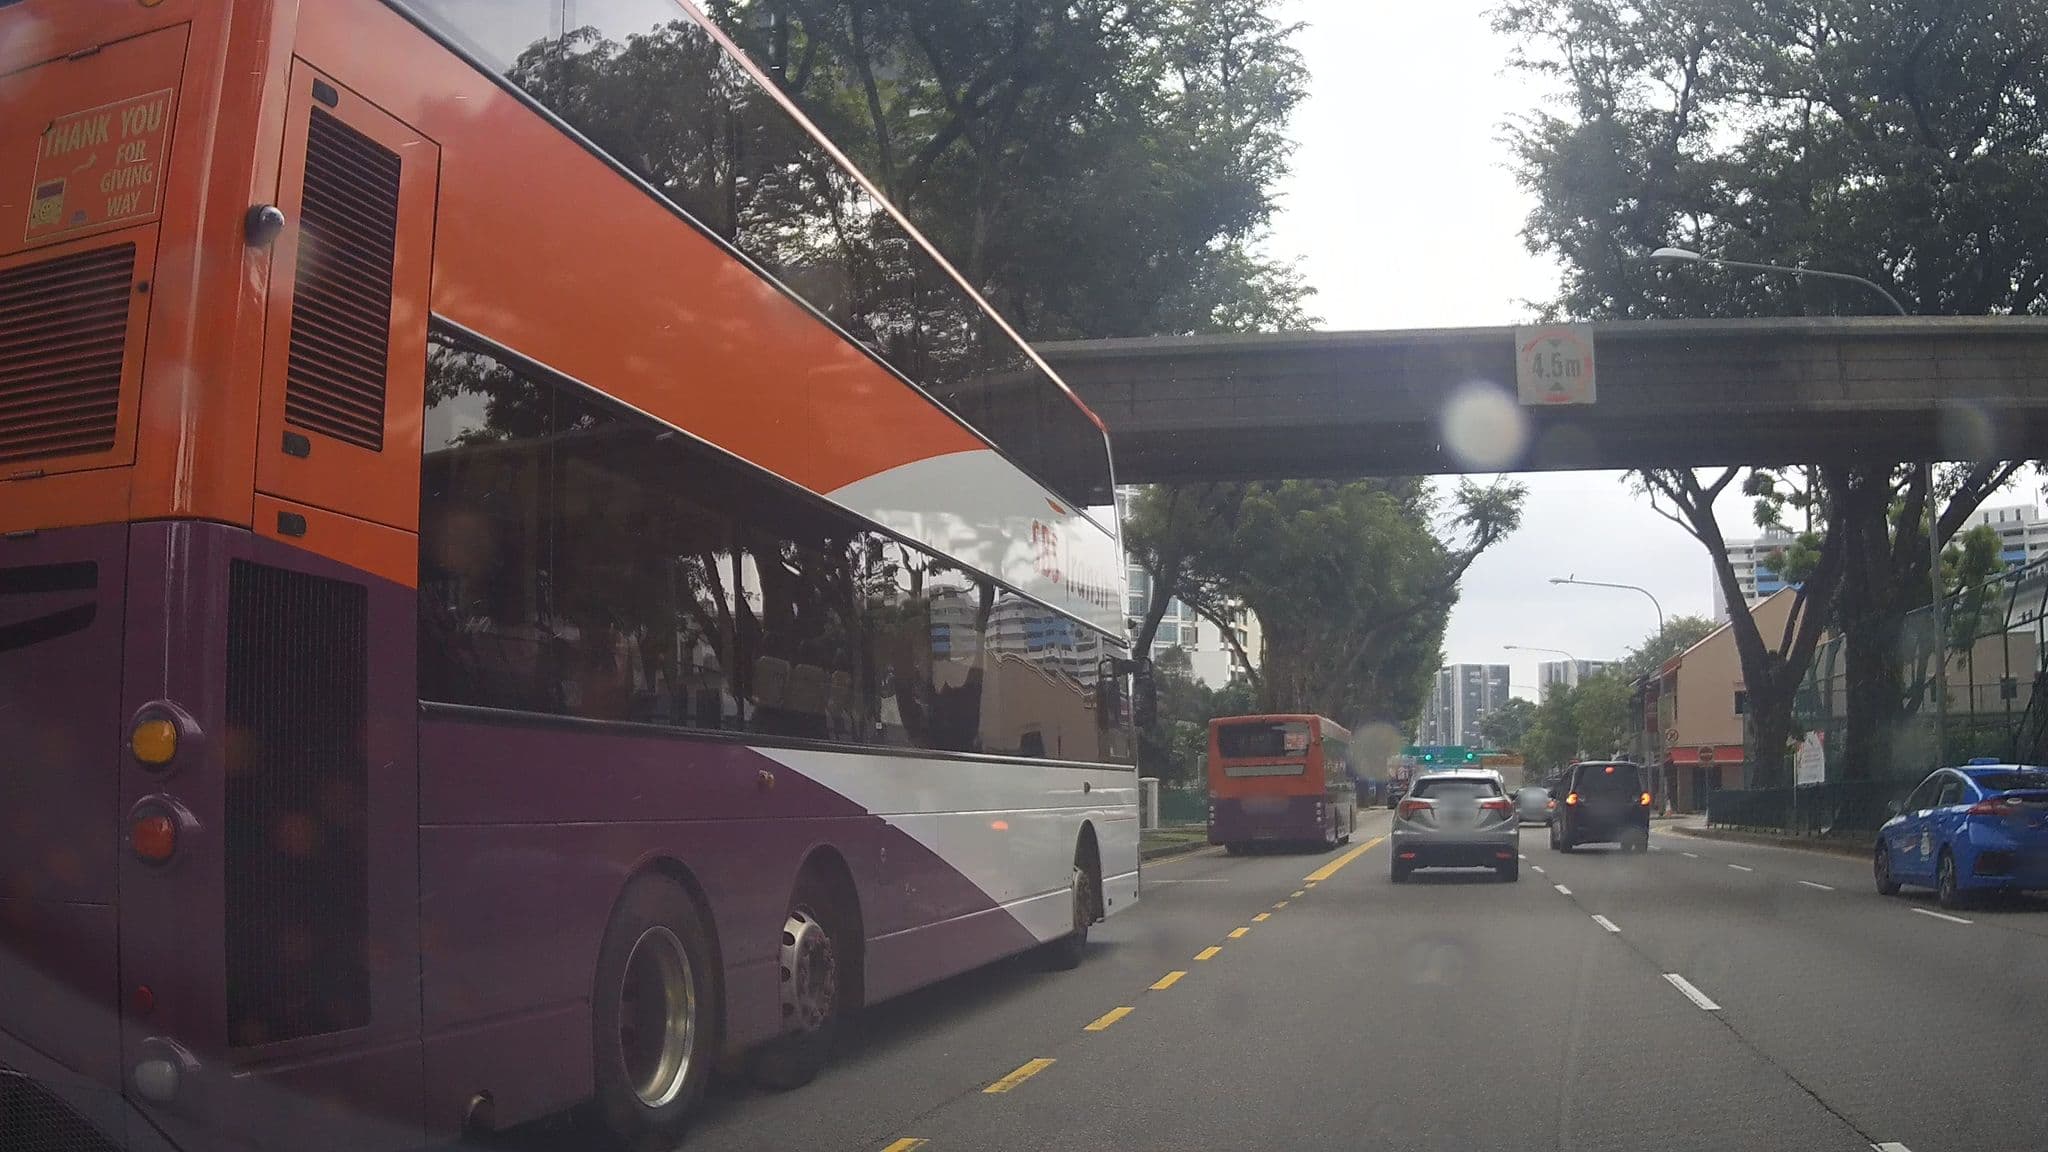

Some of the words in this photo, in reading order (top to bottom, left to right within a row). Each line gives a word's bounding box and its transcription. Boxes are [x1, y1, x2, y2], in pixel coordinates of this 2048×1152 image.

[44, 113, 112, 158] THANK
[121, 100, 163, 139] YOU
[116, 140, 147, 165] FOR
[101, 162, 153, 193] GIVING
[107, 190, 141, 217] WAY
[1533, 351, 1581, 378] 4.5m
